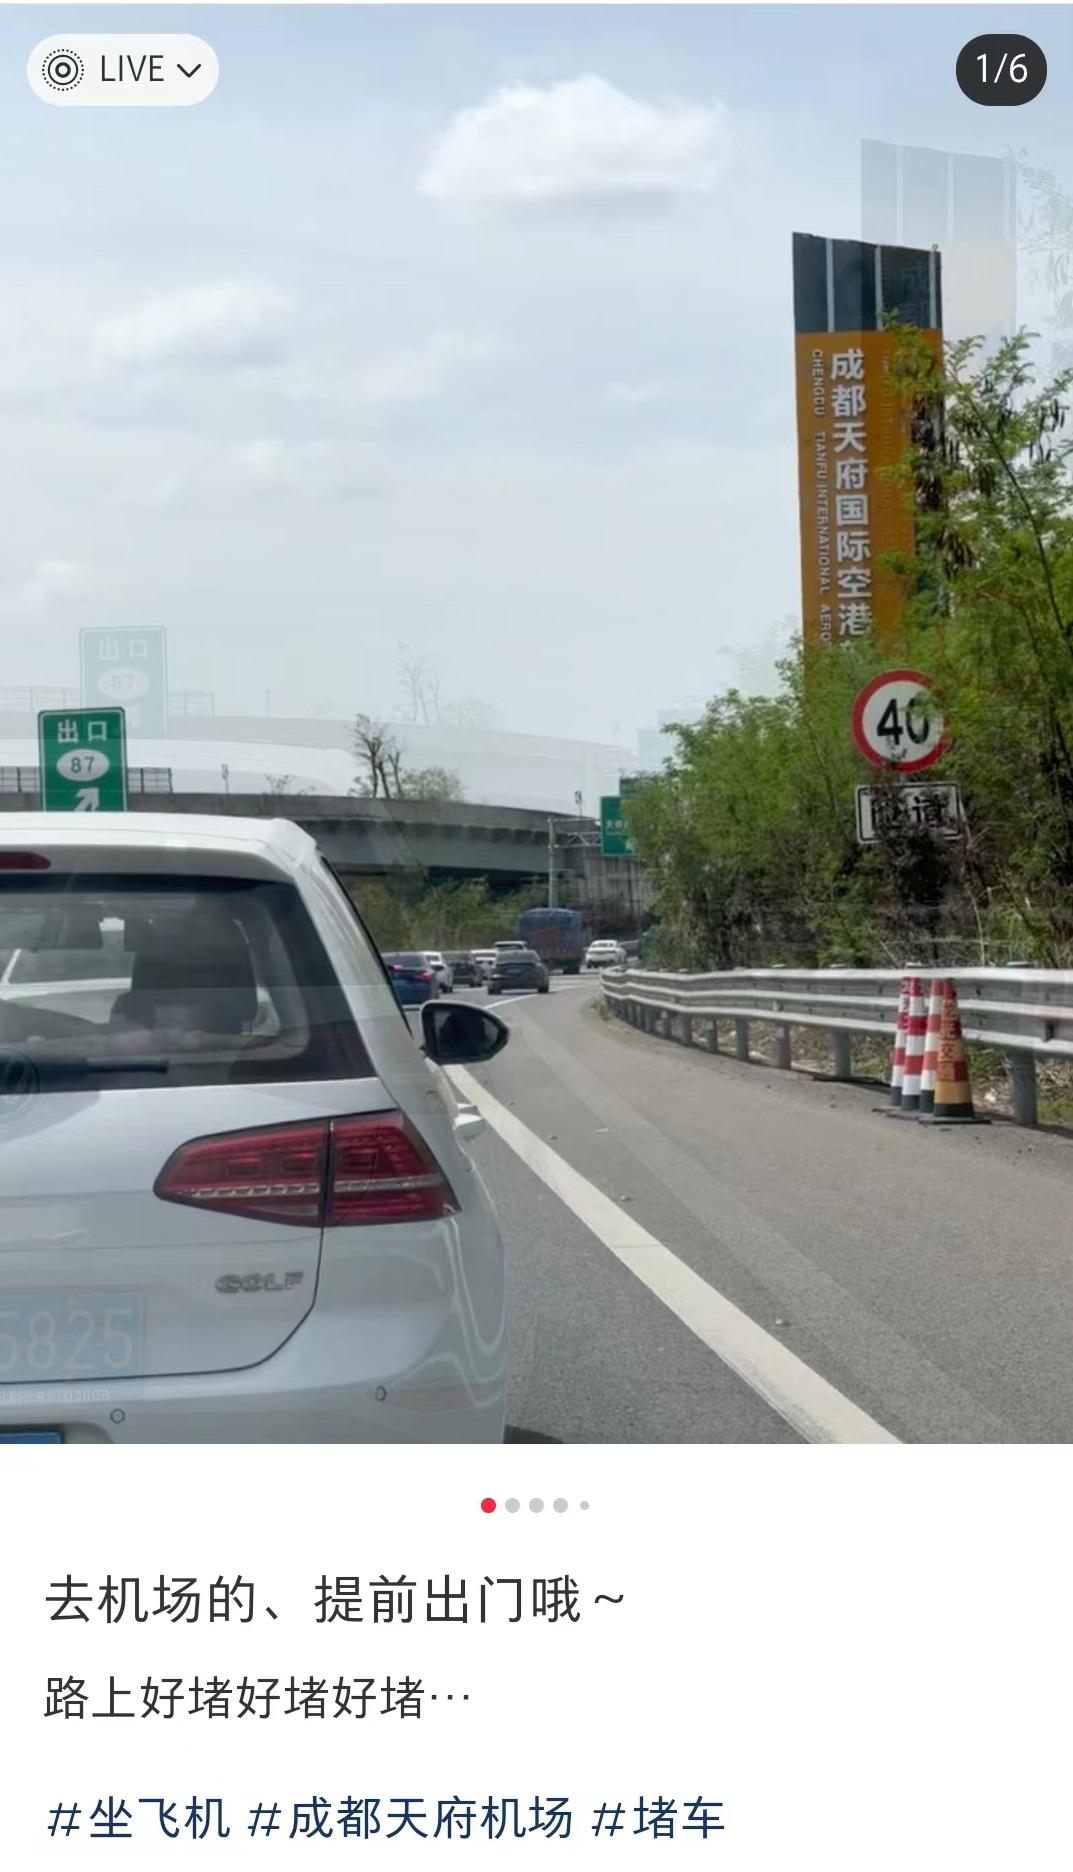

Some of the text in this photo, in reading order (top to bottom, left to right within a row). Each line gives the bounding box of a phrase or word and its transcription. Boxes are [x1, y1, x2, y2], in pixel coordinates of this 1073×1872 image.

[811, 349, 834, 646] CHENGDU TIANFU INTERNATIONAL AERO
[830, 347, 874, 650] 成都天府国际空港
[57, 718, 108, 744] 出口
[876, 697, 930, 745] 40
[70, 756, 95, 774] 87
[214, 1271, 305, 1294] GOLF
